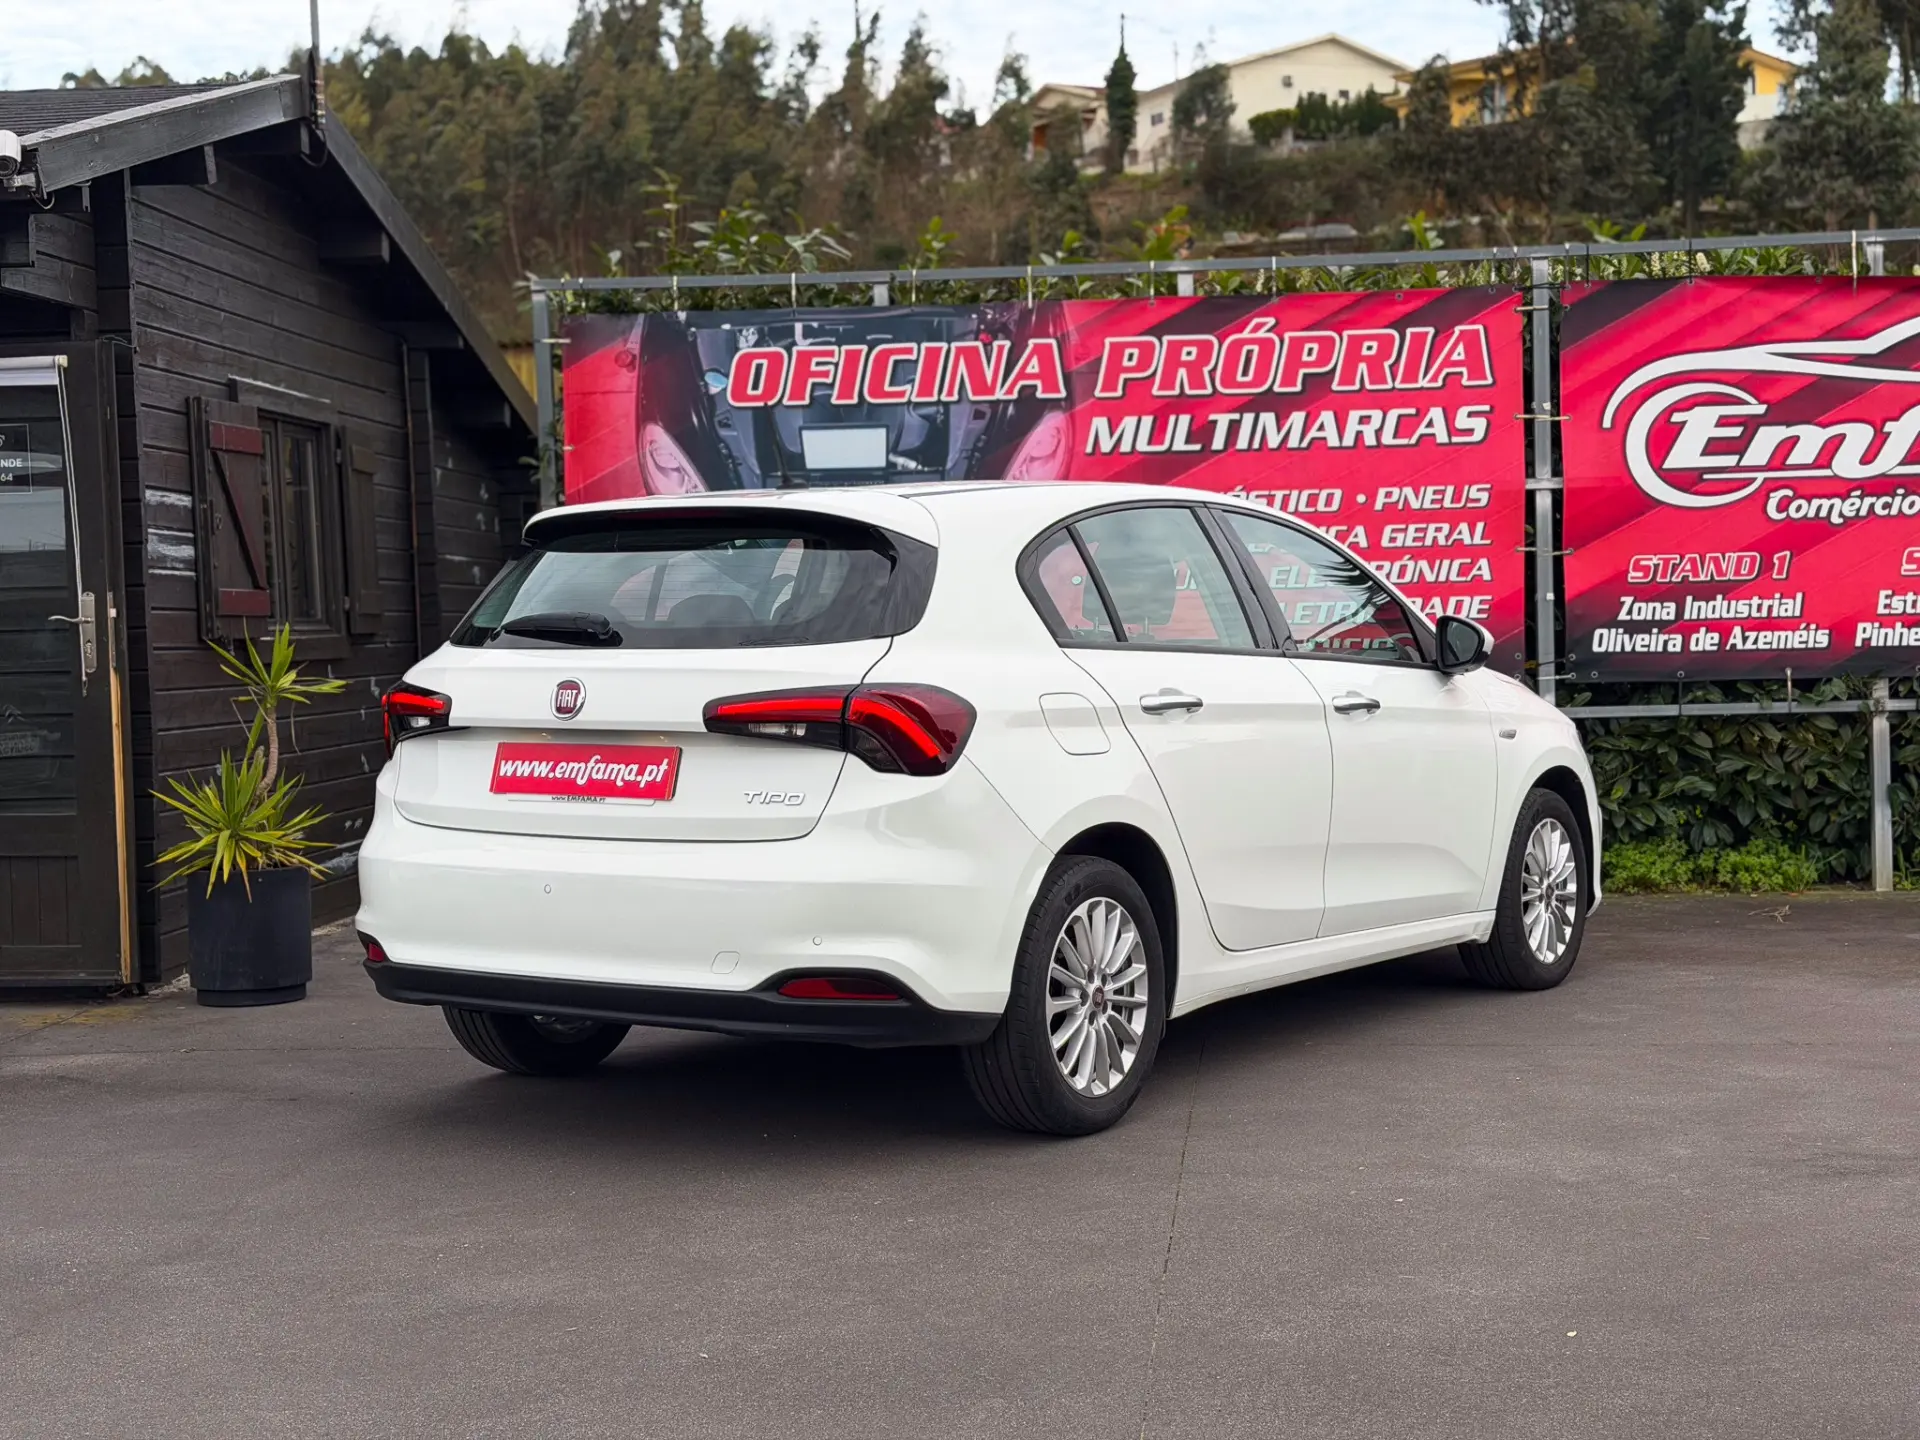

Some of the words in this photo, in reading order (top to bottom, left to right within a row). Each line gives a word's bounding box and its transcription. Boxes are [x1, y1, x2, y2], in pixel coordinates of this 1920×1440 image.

[727, 338, 1067, 407] OFICINA
[1094, 317, 1495, 398] PRÓPRIA
[1085, 404, 1492, 455] MULTIMARCAS
[1374, 484, 1492, 511] PNEUS
[1381, 522, 1492, 548] GERAL
[1628, 552, 1760, 583] STAND
[1772, 550, 1791, 579] 1
[1616, 596, 1676, 621] Zona
[1683, 592, 1803, 620] Industrial
[1592, 628, 1682, 653] Oliveira
[1690, 628, 1720, 652] de
[1725, 625, 1830, 651] Azeméis
[556, 689, 579, 708] FIAT
[499, 755, 669, 788] www.emfama.pt
[743, 790, 806, 806] TIPO
